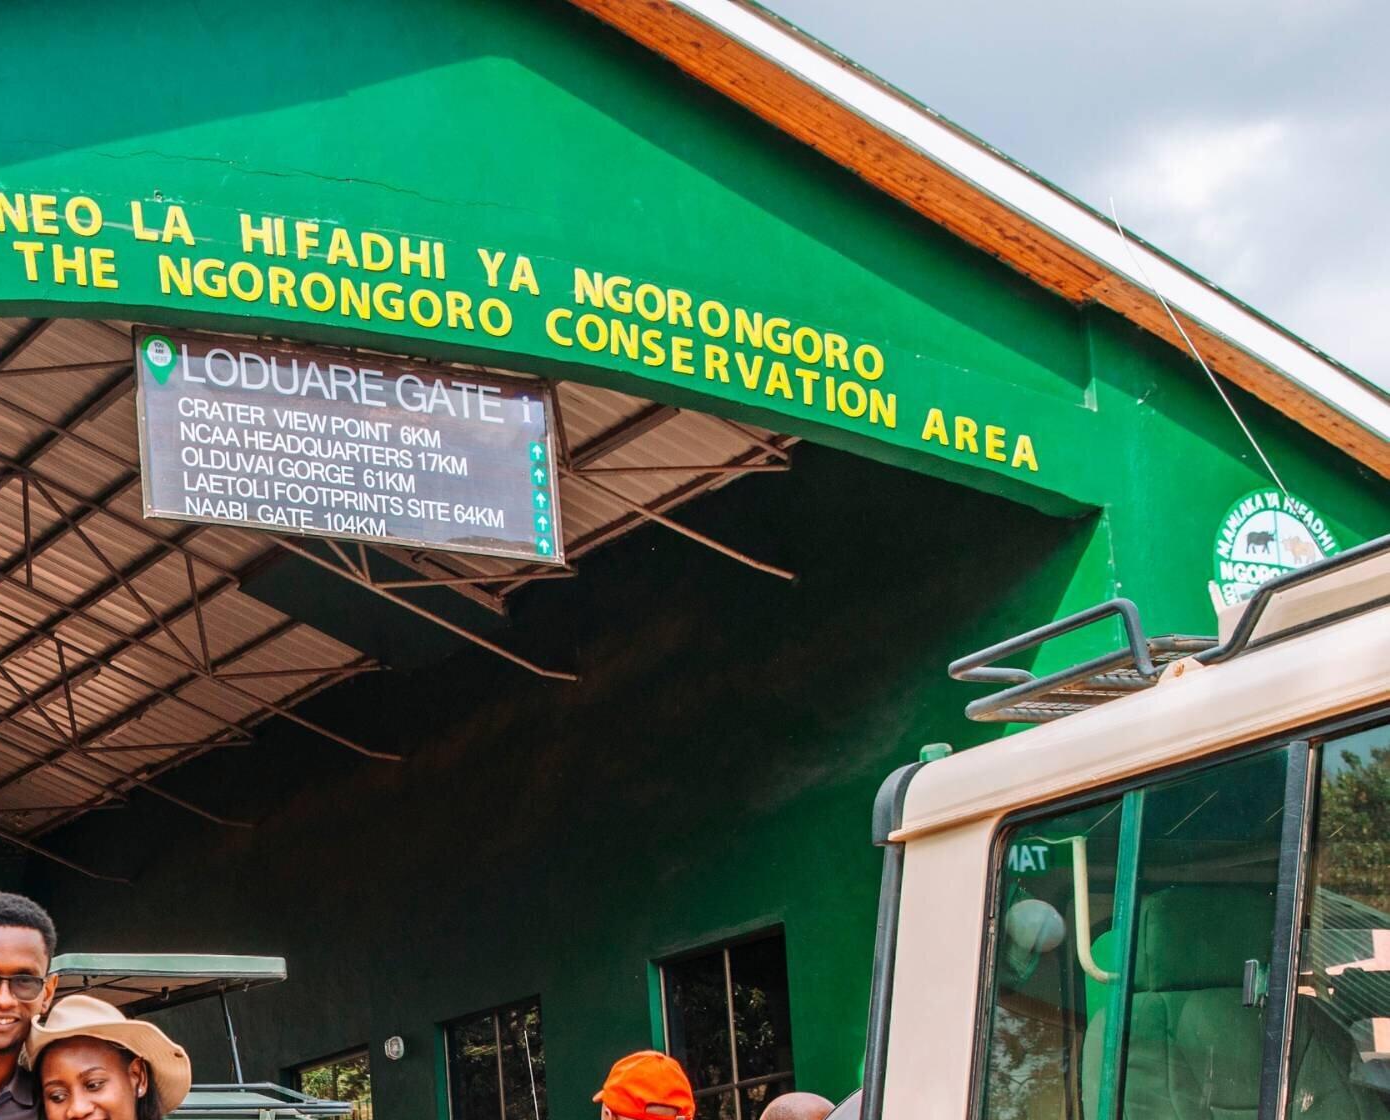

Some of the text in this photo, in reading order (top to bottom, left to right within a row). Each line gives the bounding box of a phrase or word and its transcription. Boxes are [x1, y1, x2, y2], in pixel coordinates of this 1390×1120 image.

[131, 201, 196, 246] LA
[240, 213, 446, 280] HIFADHI
[477, 248, 540, 296] YA
[574, 268, 885, 381] NGORONGORO
[13, 241, 119, 289] THE
[158, 254, 513, 337] NGORONGORO
[545, 308, 896, 429] CONSERVATION
[922, 407, 1040, 472] AREA
[181, 344, 506, 425] LODUARE GATE
[178, 397, 442, 449] CRATER VIEW POINT 6KM
[180, 422, 468, 476] NCAA HEADQUARTERS 17KM
[181, 446, 416, 494] OLDUVAI GORGE 61KM
[183, 471, 505, 529] LAETOLI FOOTPRINTS SITE 64KM
[185, 496, 387, 537] NAABI GATE 104KM
